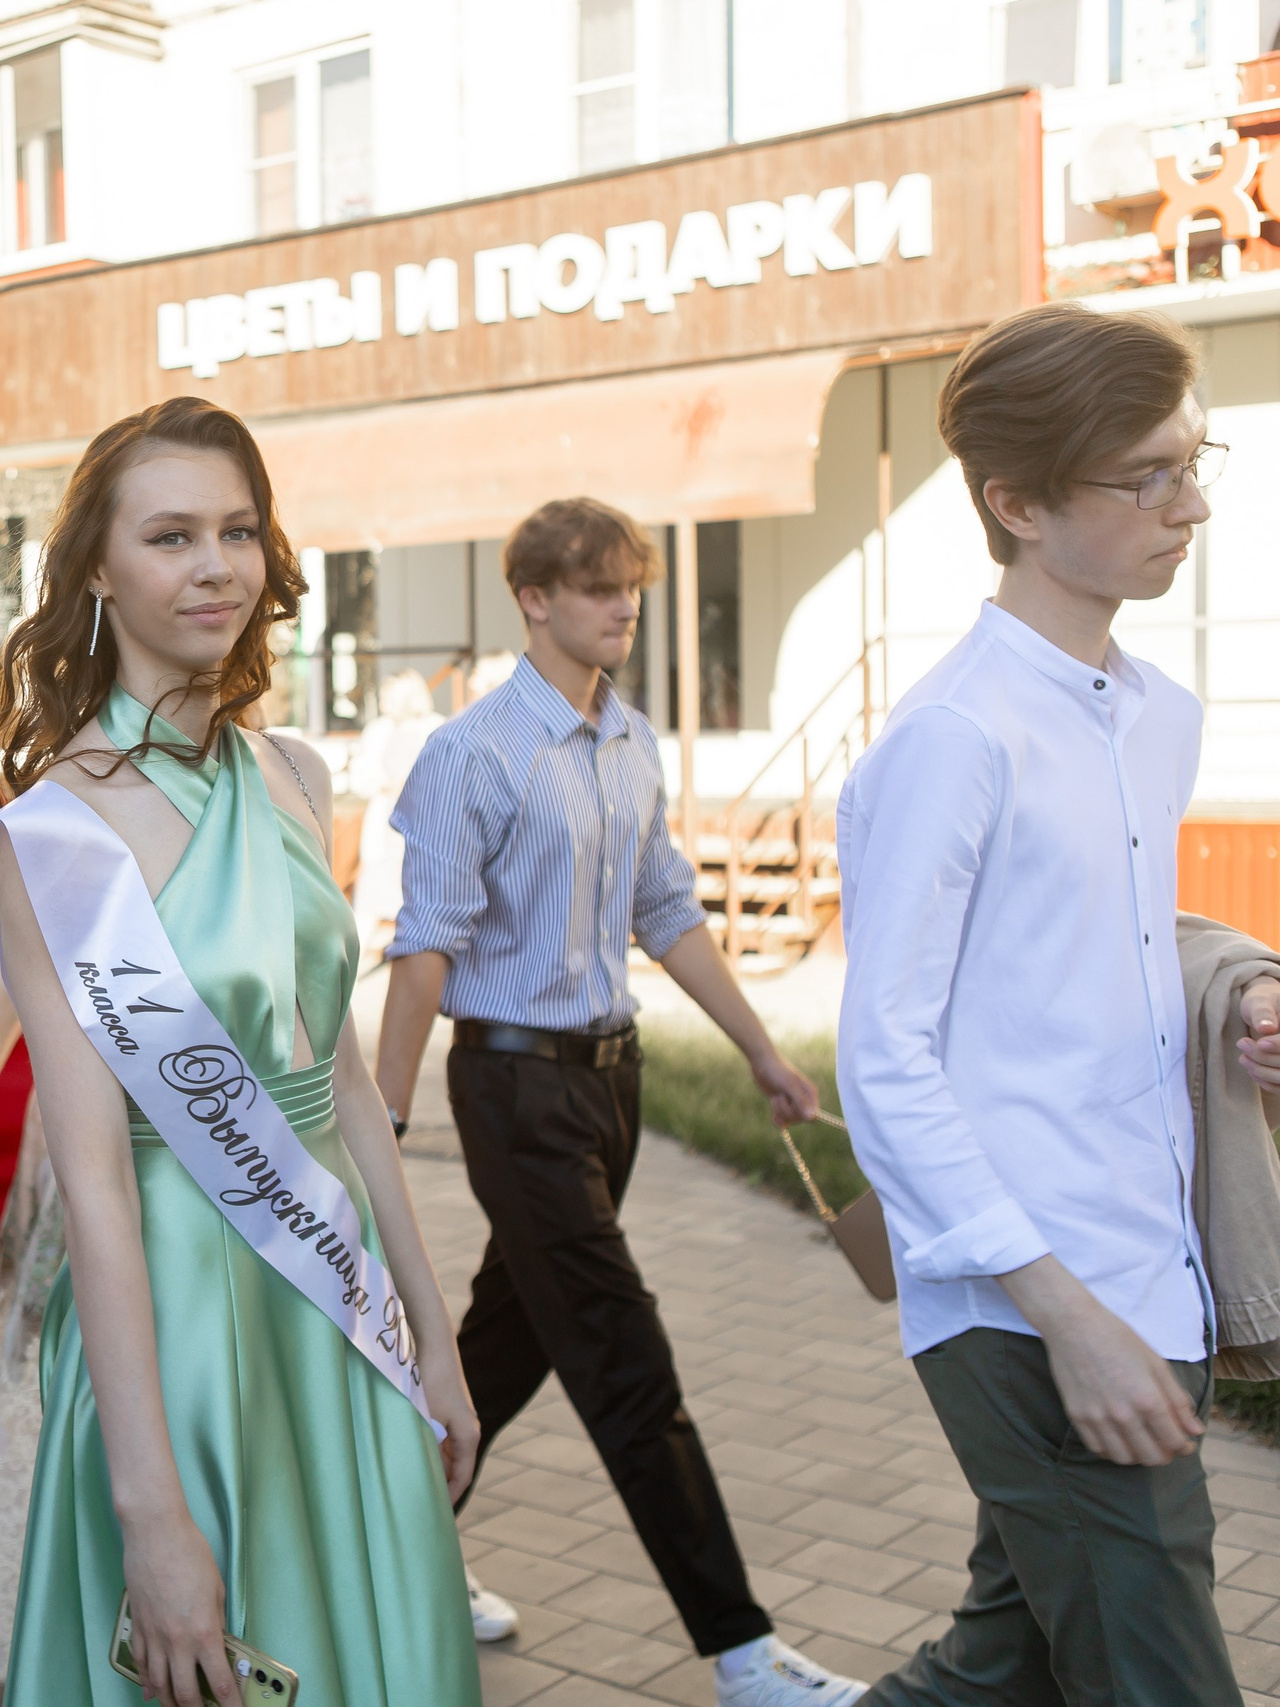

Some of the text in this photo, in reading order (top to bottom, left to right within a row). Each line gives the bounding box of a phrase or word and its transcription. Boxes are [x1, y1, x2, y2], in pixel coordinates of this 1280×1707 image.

[157, 172, 934, 379] ЦВЕТЫ И ПОДАРКИ
[73, 961, 141, 1056] класса
[109, 958, 185, 1015] 11
[158, 1044, 372, 1316] Выпускница
